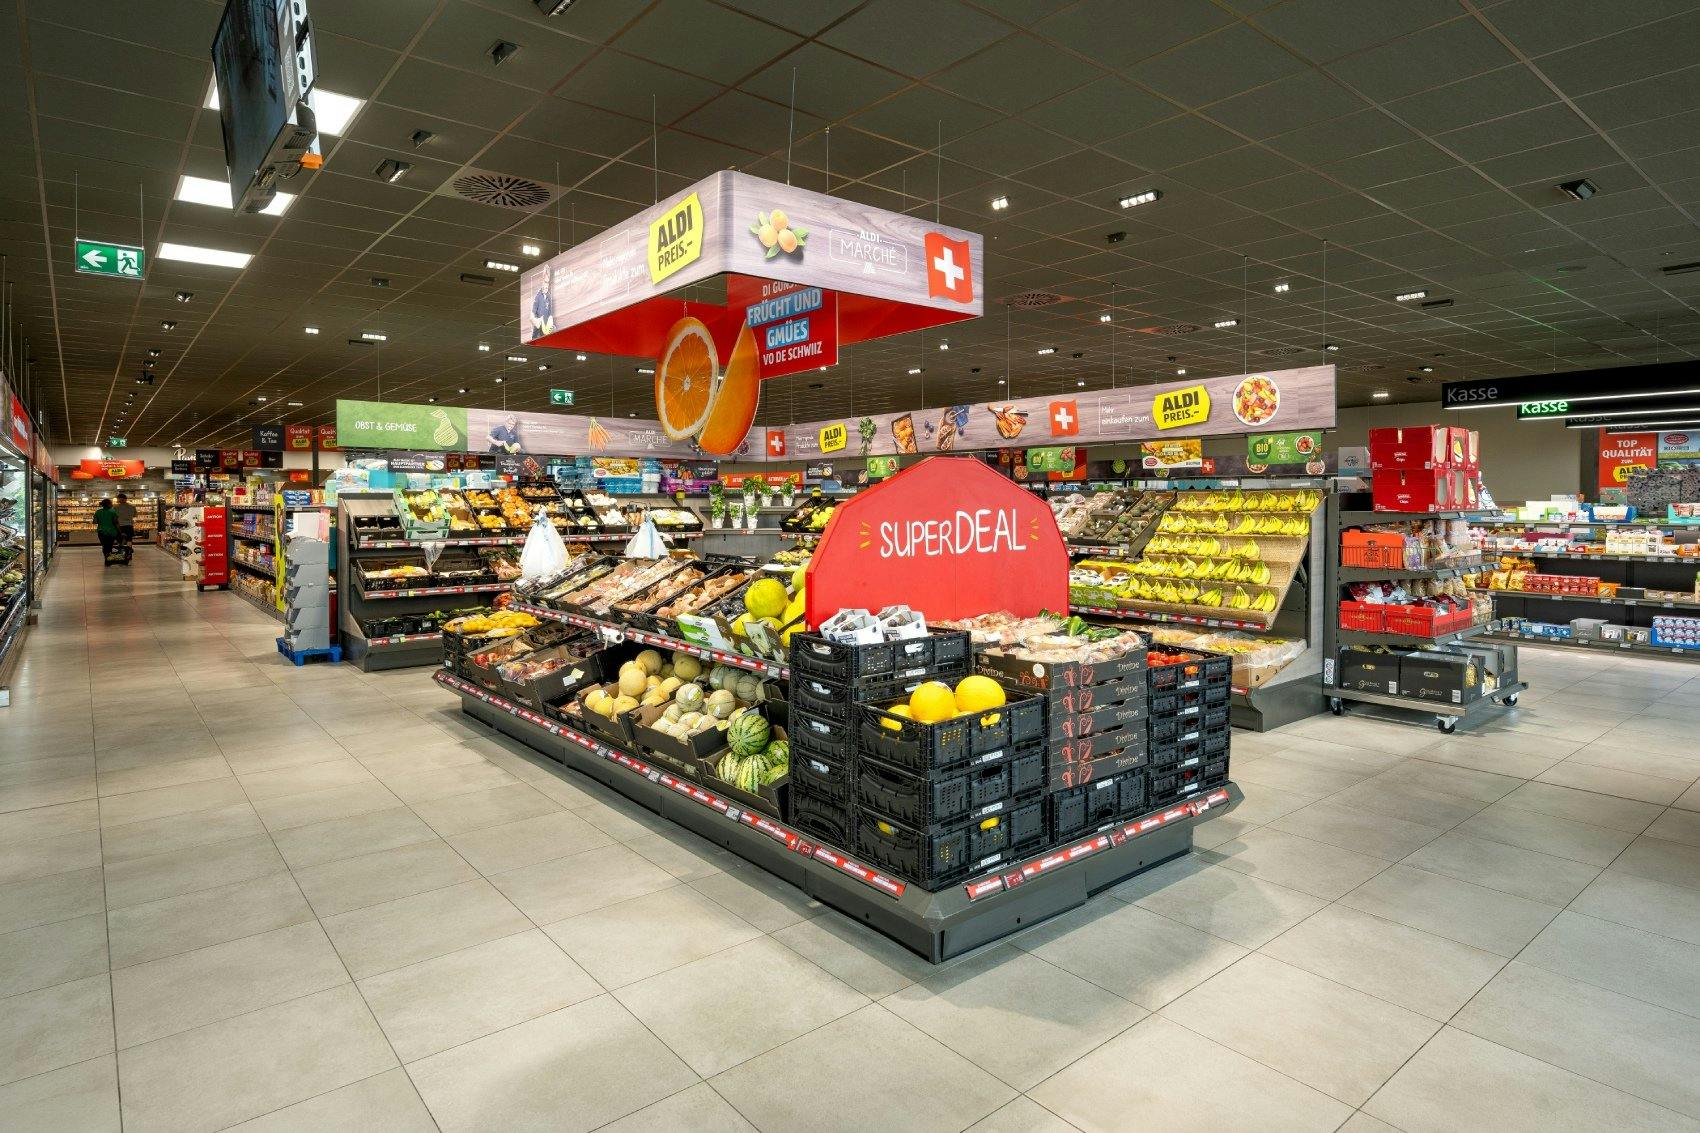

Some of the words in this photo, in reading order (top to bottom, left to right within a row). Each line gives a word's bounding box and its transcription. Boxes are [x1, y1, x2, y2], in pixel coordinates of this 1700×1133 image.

[657, 204, 693, 253] ALDI
[859, 230, 880, 243] ALDI
[840, 238, 897, 265] MARCHÉ
[747, 297, 792, 326] FRÜCHT
[793, 288, 821, 312] UND
[766, 319, 808, 348] GMÜES
[763, 353, 775, 366] VO
[775, 350, 787, 362] DE
[1447, 385, 1499, 402] Kasse
[1162, 391, 1200, 412] ALDI
[1521, 400, 1568, 414] Kasse
[355, 420, 375, 430] OBST
[376, 422, 383, 431] &
[384, 421, 417, 433] GEMÜSE
[823, 428, 842, 441] ALDI
[1256, 444, 1269, 453] BIO
[1616, 440, 1638, 448] TOP
[1602, 446, 1653, 459] QUALITÄT
